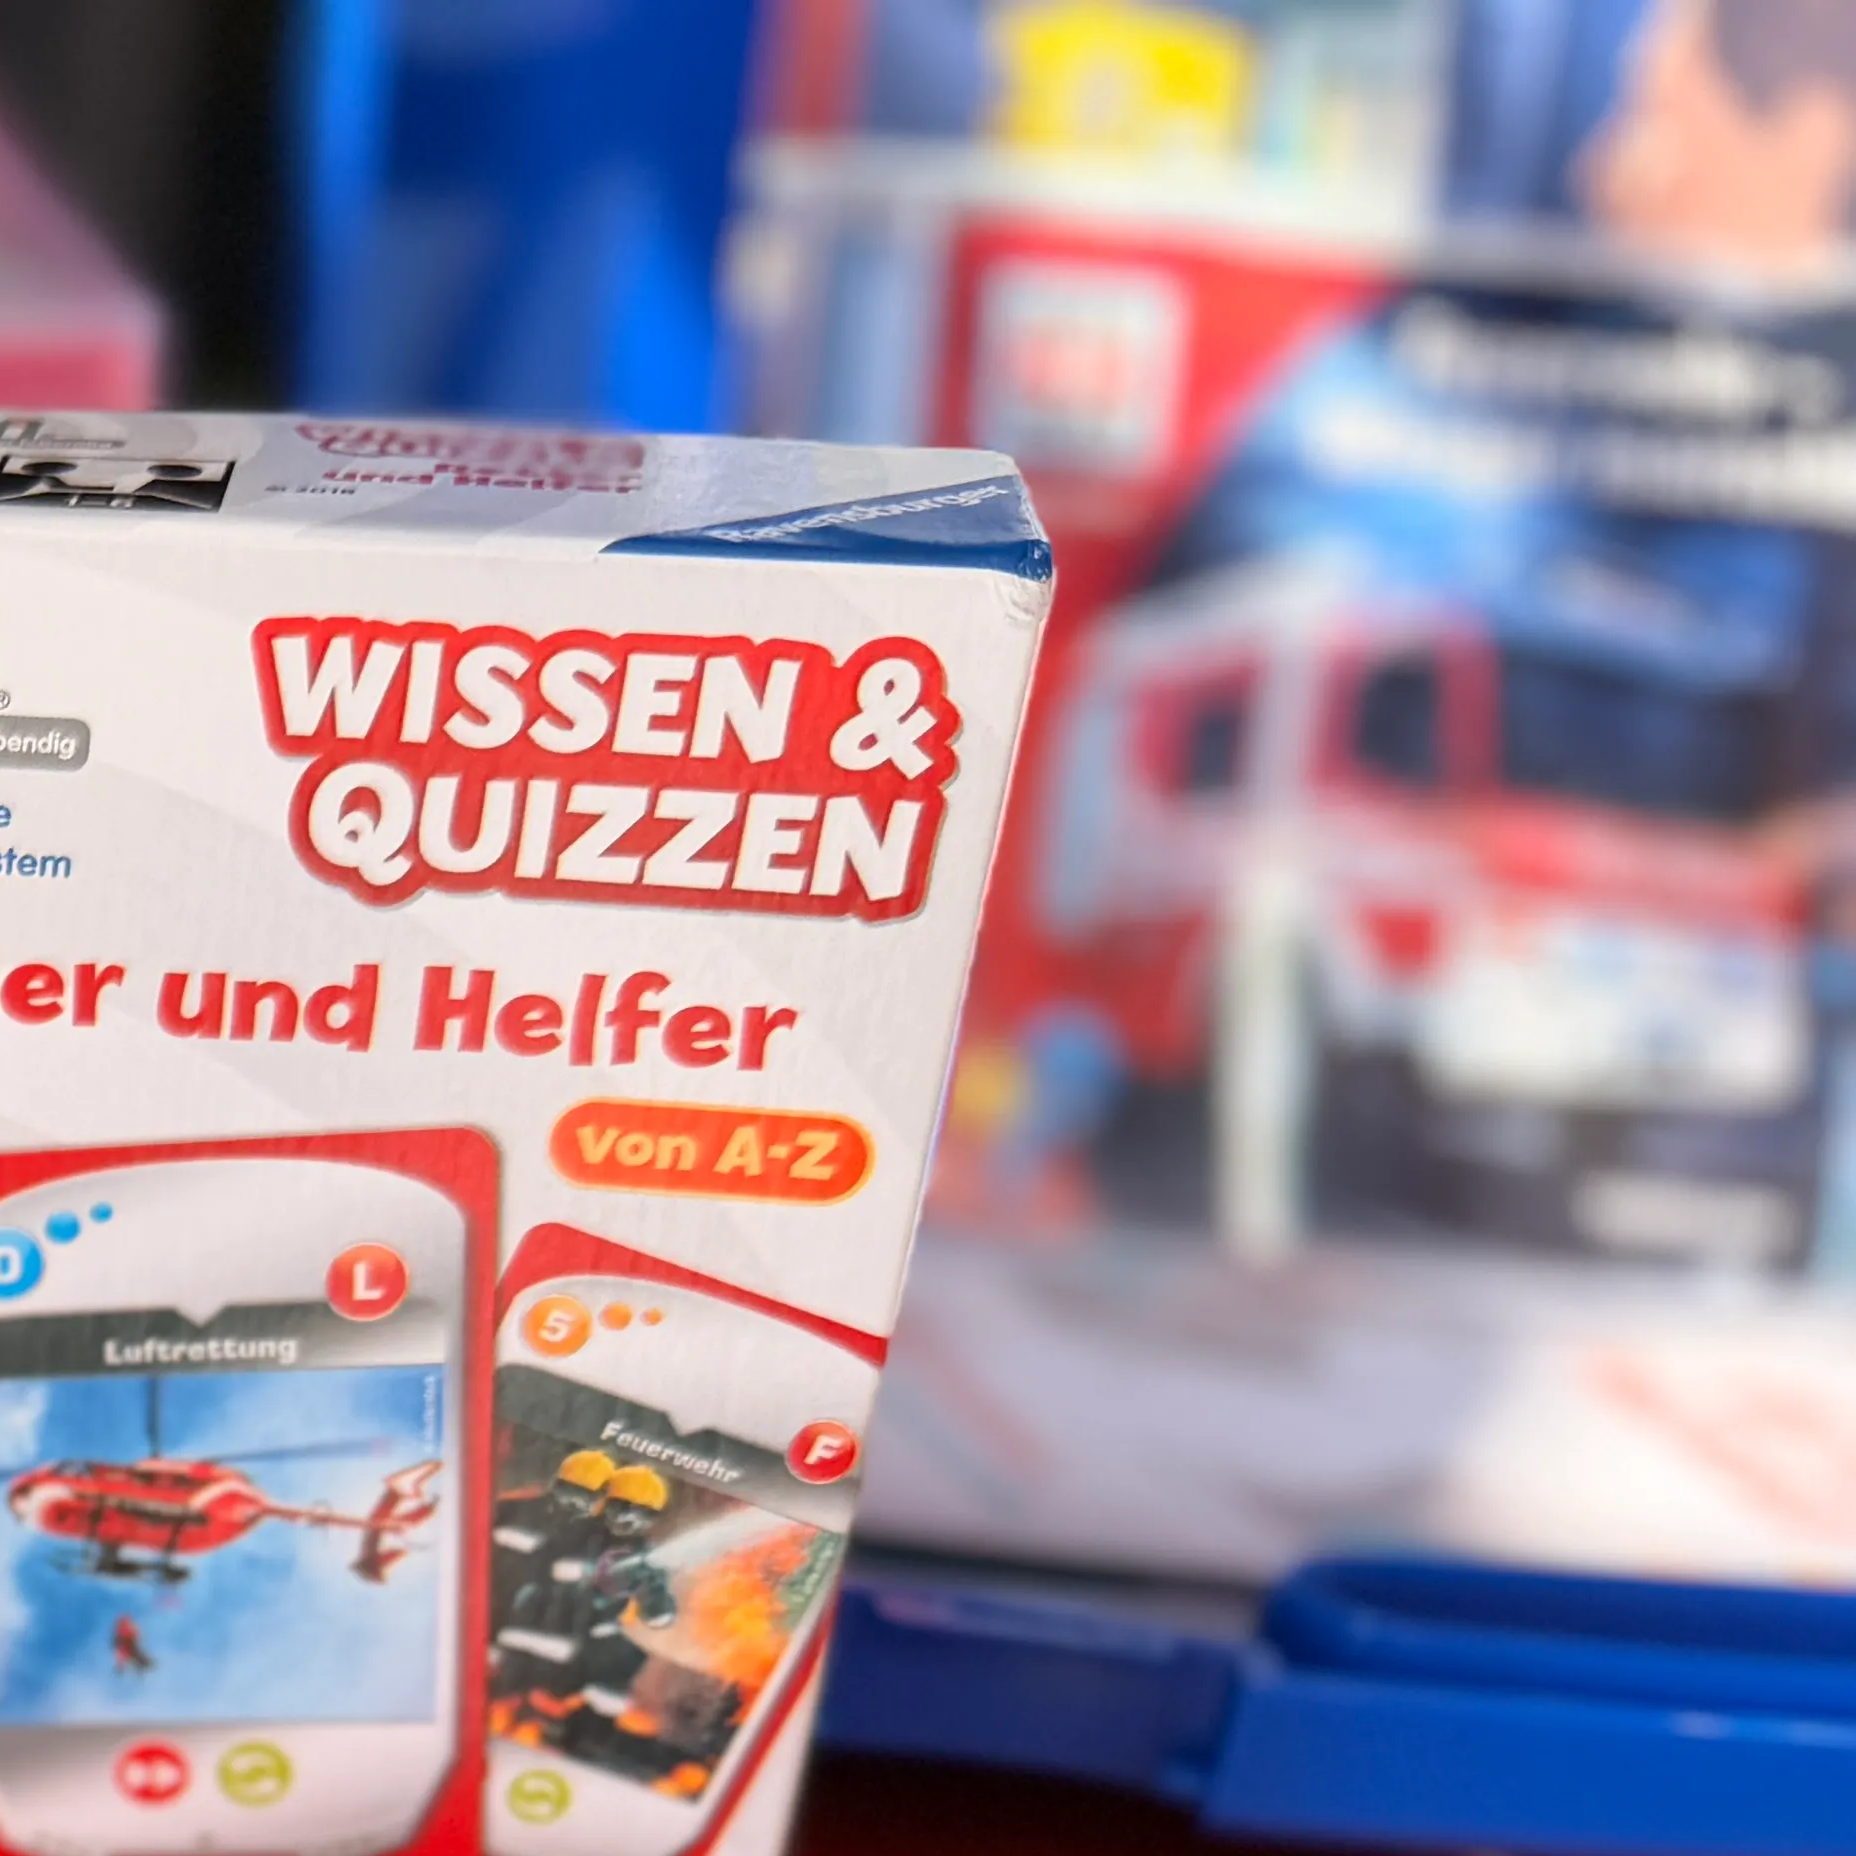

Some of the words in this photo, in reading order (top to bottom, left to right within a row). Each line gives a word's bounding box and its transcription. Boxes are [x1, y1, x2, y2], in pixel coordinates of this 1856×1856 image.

[702, 484, 1010, 544] Ravensburger
[269, 634, 803, 765] WISSEN
[828, 656, 938, 781] &
[306, 761, 923, 902] QUIZZEN
[155, 961, 380, 1053] und
[412, 965, 800, 1072] Helfer
[575, 1124, 697, 1175] von
[716, 1131, 841, 1182] A-Z
[350, 1260, 386, 1302] L
[103, 1335, 298, 1368] Luftrettung
[599, 1418, 743, 1485] Feuerwehr
[802, 1433, 842, 1466] F
